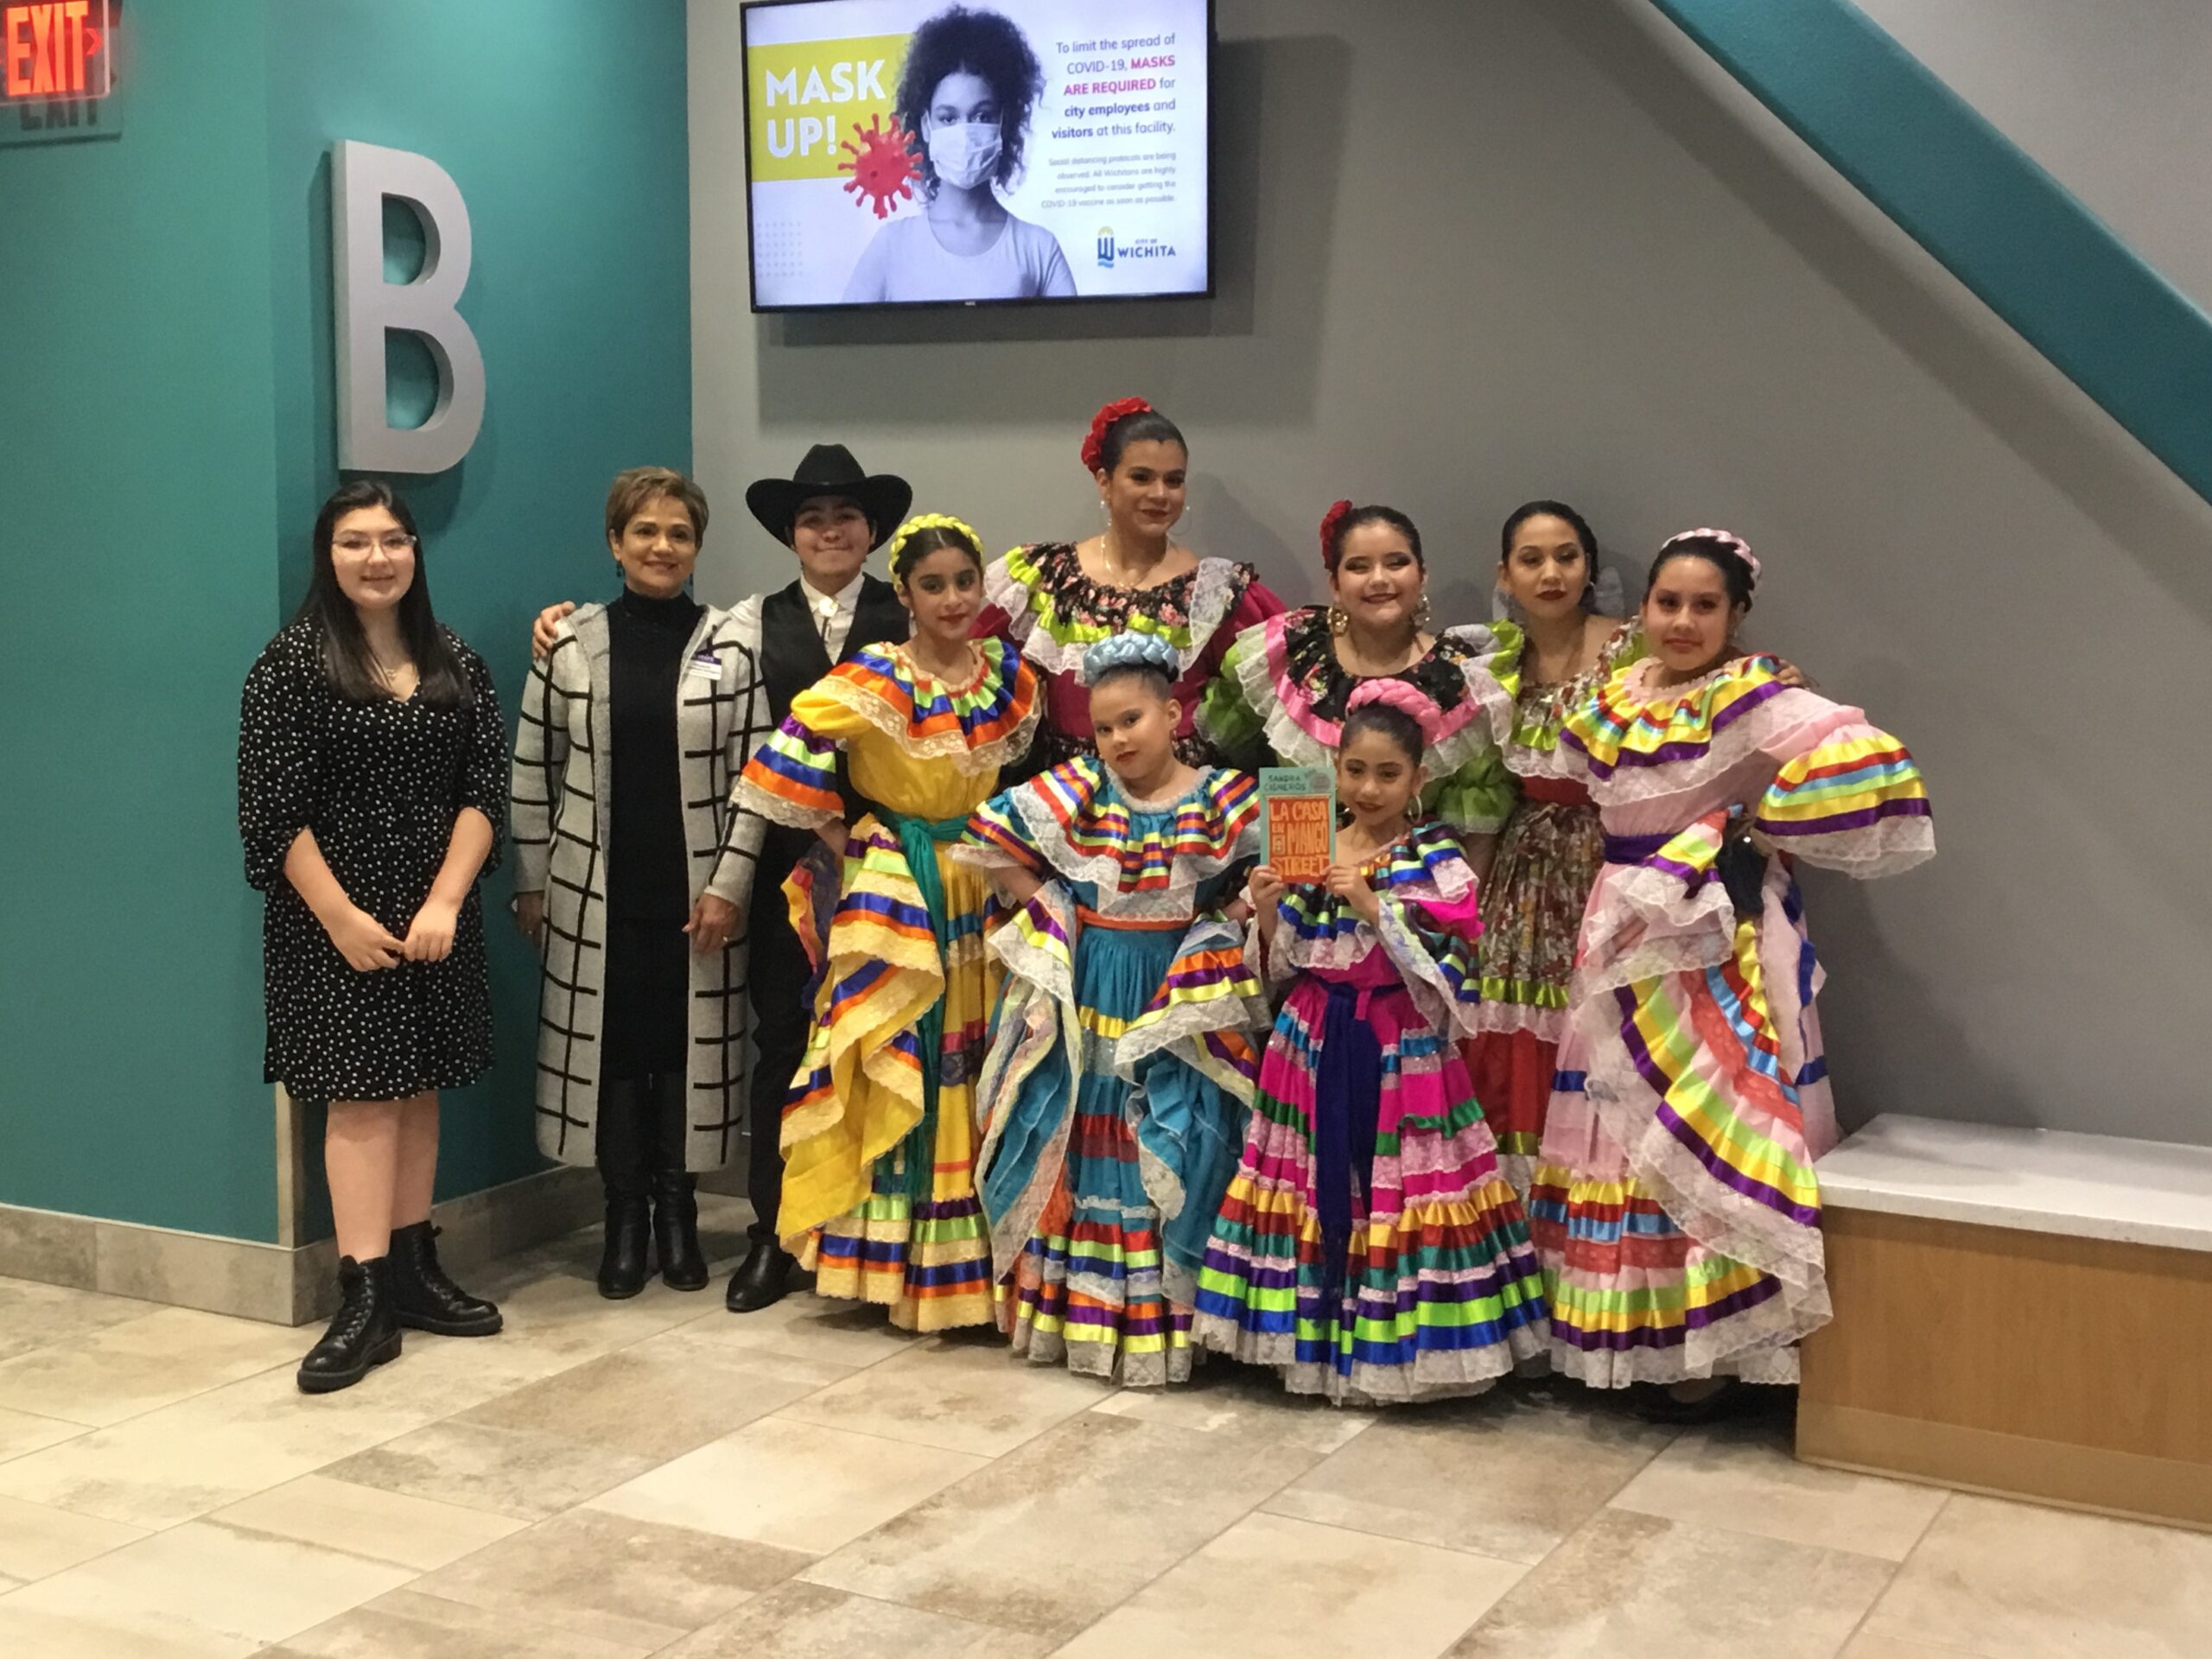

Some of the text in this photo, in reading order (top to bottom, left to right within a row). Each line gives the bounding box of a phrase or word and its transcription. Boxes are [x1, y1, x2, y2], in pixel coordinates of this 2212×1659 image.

[7, 1, 89, 96] EXIT
[1056, 33, 1175, 54] To limit the spread of
[1067, 55, 1175, 74] COVID-19, MASKS
[766, 59, 886, 106] MASK
[1064, 77, 1175, 96] ARE REQUIRED for
[1065, 99, 1176, 119] city employees and
[767, 115, 836, 157] UP!
[1052, 120, 1176, 139] visitors at this facility.
[1117, 245, 1177, 257] WICHITA
[332, 139, 486, 474] B
[1270, 800, 1328, 821] LA CASA
[1272, 821, 1328, 855] EN MANGO
[1270, 855, 1330, 877] STREET
